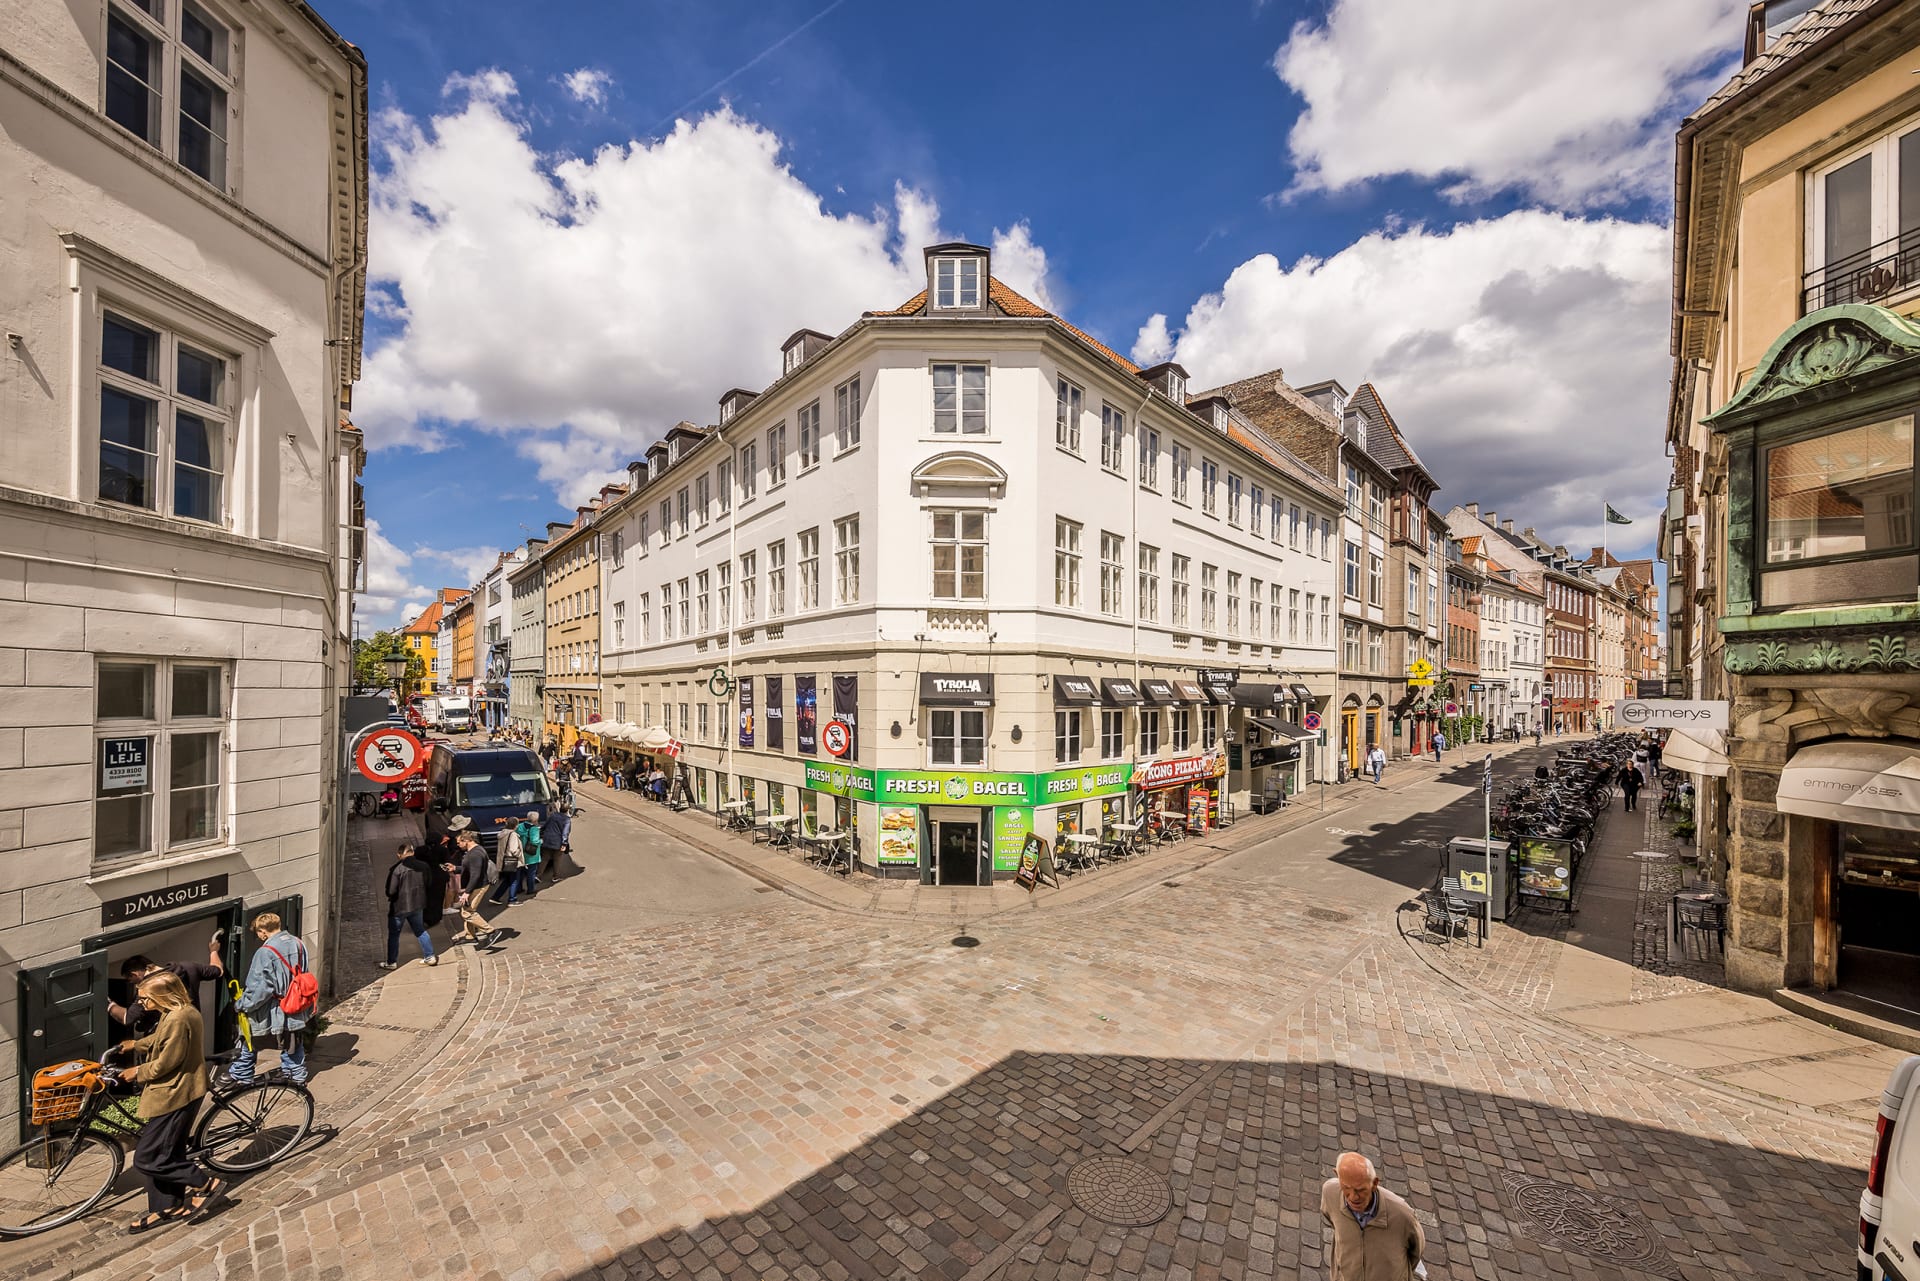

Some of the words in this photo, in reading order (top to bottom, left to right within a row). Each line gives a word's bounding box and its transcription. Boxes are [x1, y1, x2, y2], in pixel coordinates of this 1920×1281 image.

[1625, 707, 1711, 720] emmerys
[115, 741, 137, 752] TIL
[110, 752, 142, 765] LEJE
[806, 768, 831, 783] FRESH
[1147, 764, 1172, 781] KONG
[885, 779, 940, 794] FRESH
[973, 781, 1027, 796] BAGEL
[1047, 778, 1078, 794] FRESH
[1096, 772, 1123, 787] BAGEL
[1803, 778, 1878, 796] emmerys
[125, 884, 208, 915] DMASQUE
